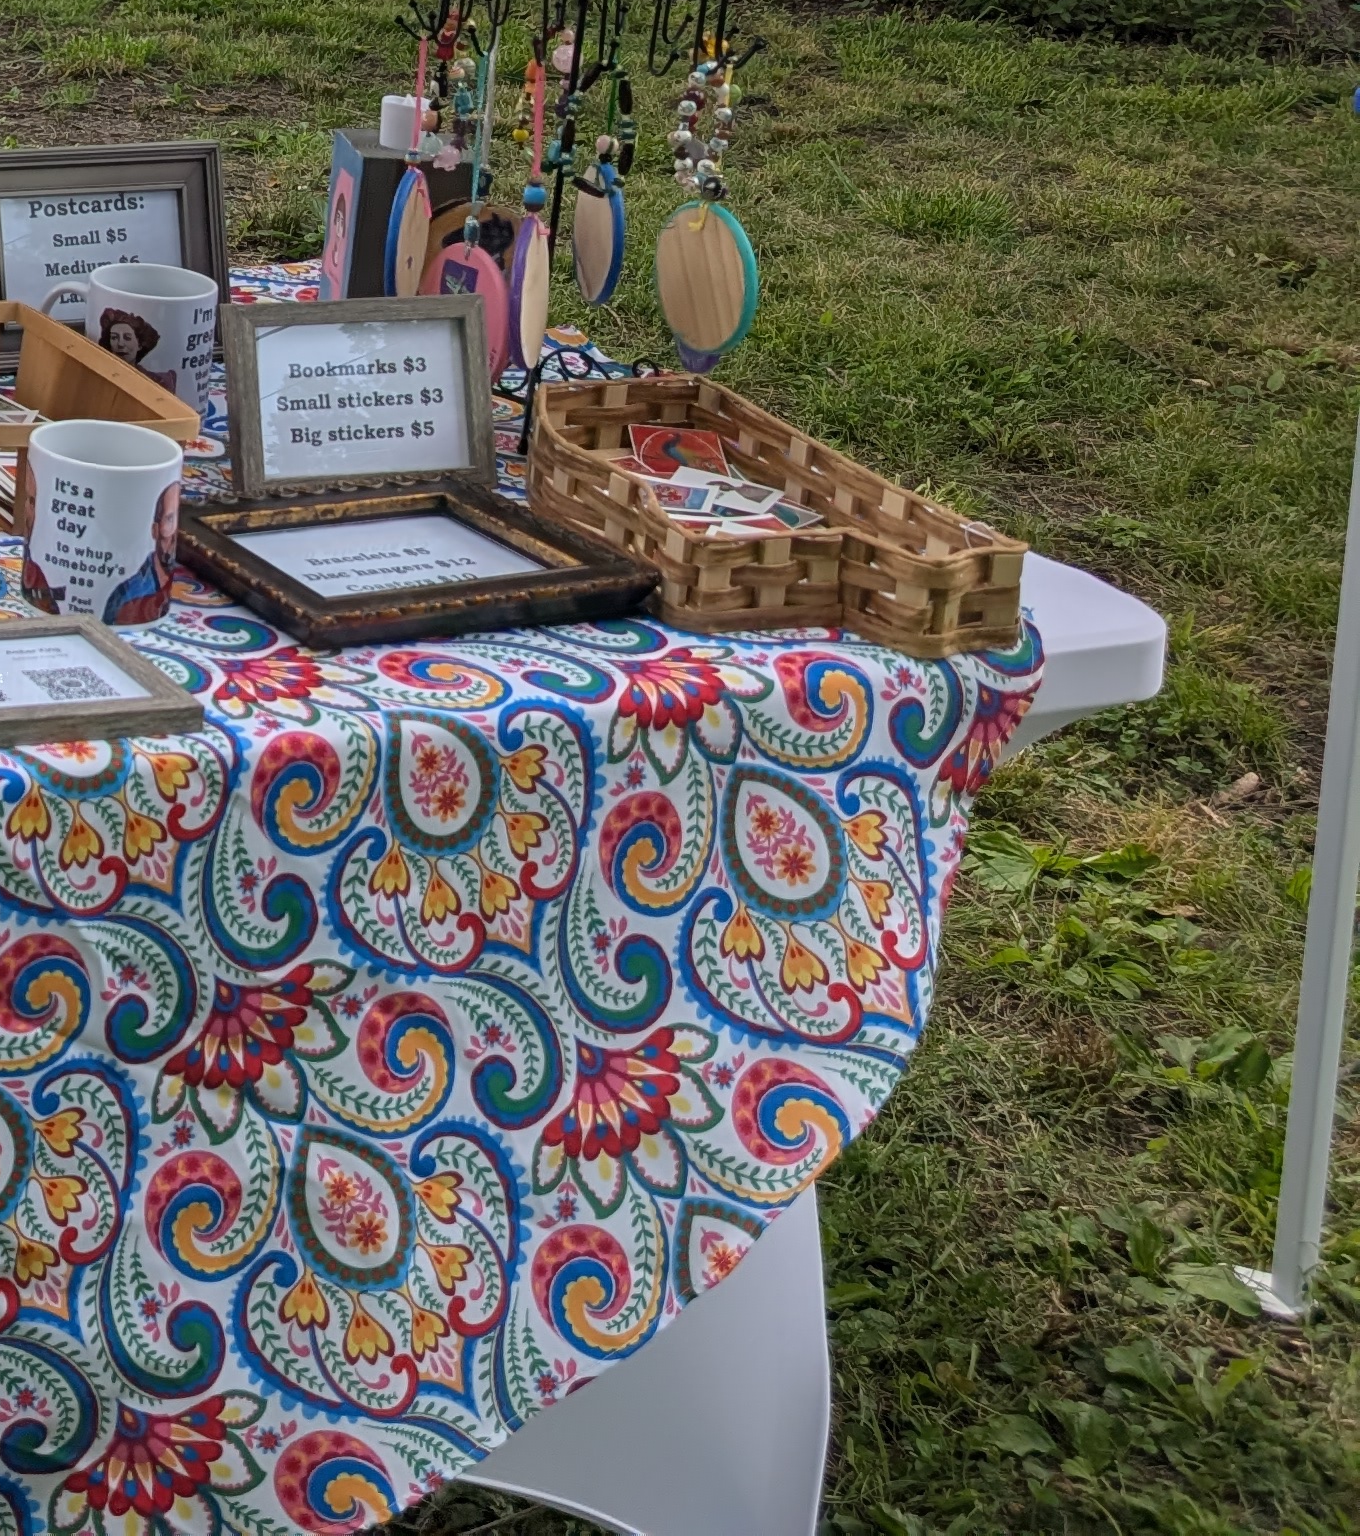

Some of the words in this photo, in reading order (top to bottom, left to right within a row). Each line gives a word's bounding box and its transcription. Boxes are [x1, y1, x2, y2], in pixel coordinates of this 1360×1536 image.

[29, 192, 145, 218] Postcards:
[53, 230, 101, 248] Small
[106, 227, 128, 245] $5
[193, 308, 213, 324] I'm
[288, 359, 398, 379] Bookmarks
[403, 356, 428, 375] $3
[276, 394, 331, 412] Small
[337, 390, 414, 409] stickers
[420, 387, 444, 406] $3
[290, 427, 323, 447] Big
[328, 424, 405, 442] stickers
[410, 420, 435, 439] $5
[55, 477, 79, 497] It's
[83, 487, 94, 499] a
[51, 498, 95, 519] great
[56, 517, 87, 539] day
[57, 541, 69, 553] to
[75, 547, 113, 563] whup
[305, 551, 401, 567] Bracelets
[402, 546, 431, 557] $5
[44, 552, 125, 579] somebody's
[302, 569, 351, 582] Disc
[351, 563, 434, 576] hangers
[435, 557, 478, 569] $12
[69, 575, 94, 588] ass
[346, 577, 436, 592] Coasters
